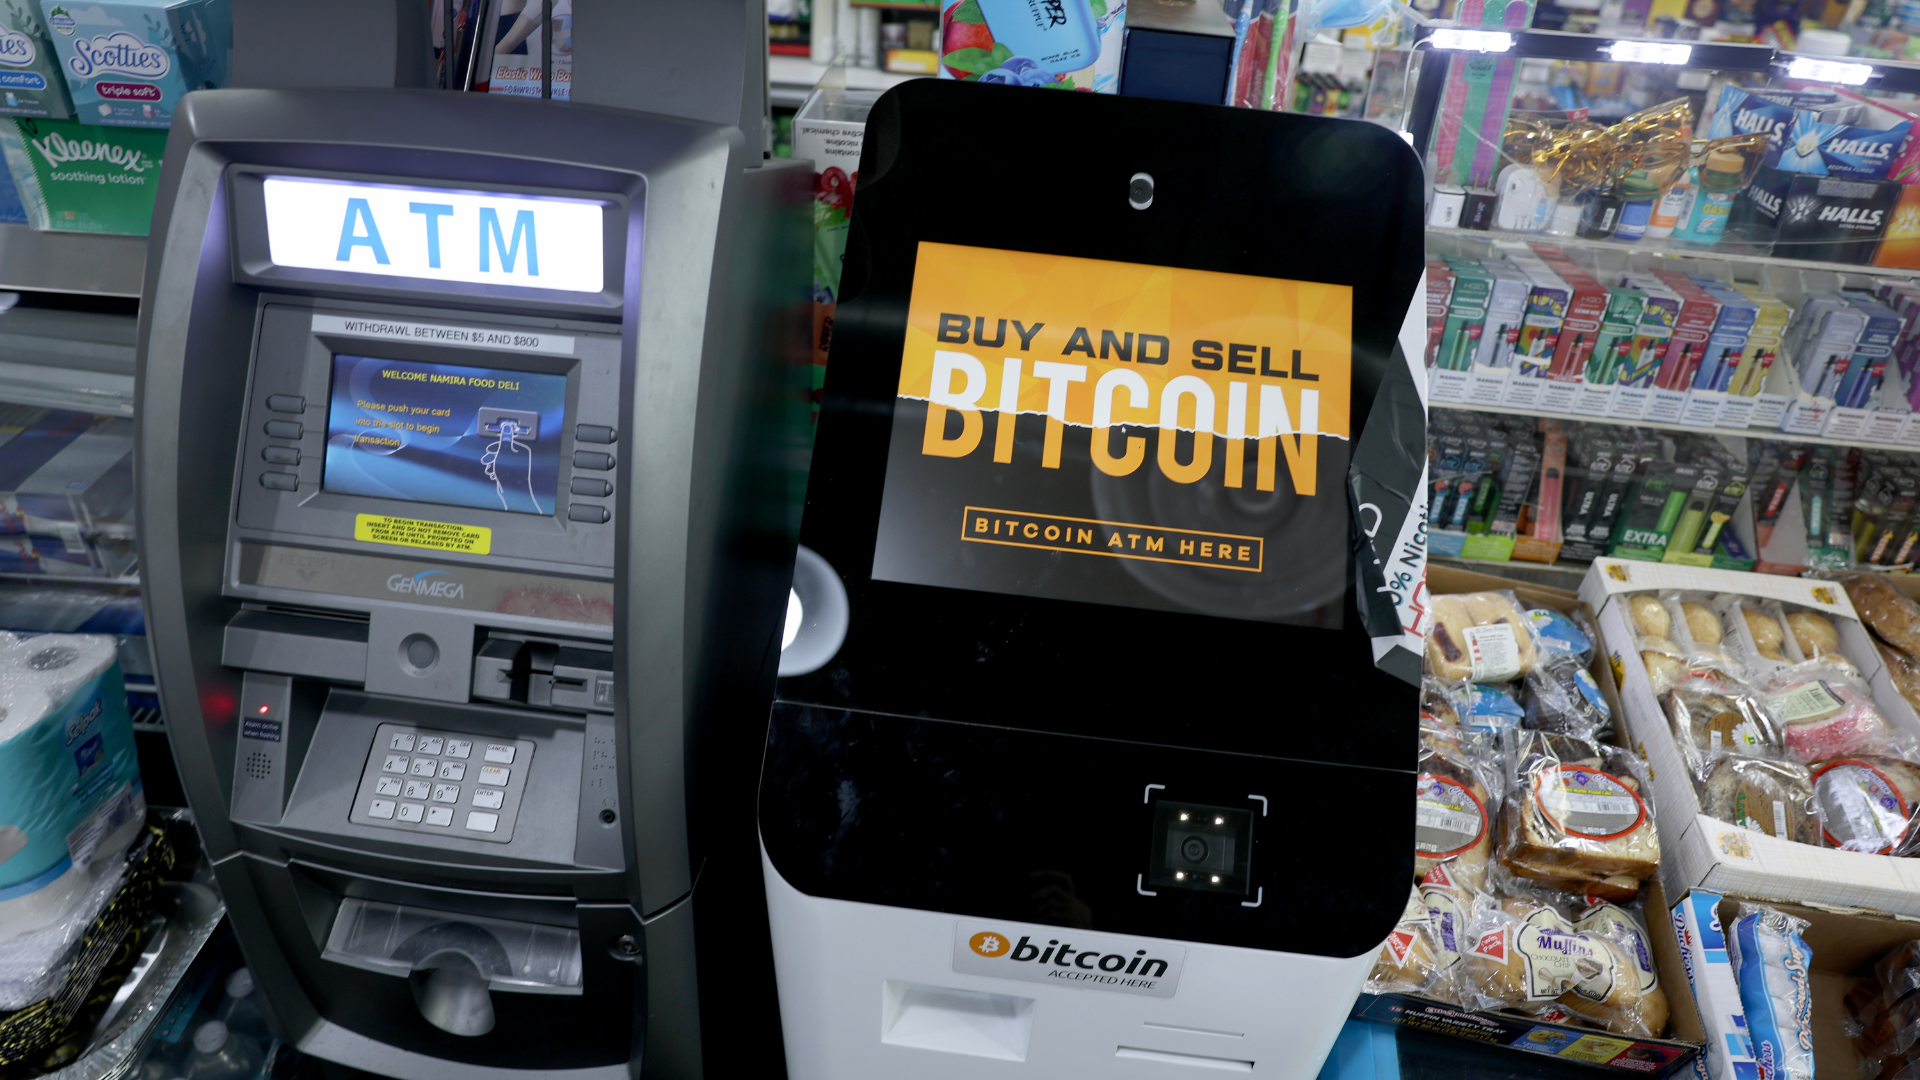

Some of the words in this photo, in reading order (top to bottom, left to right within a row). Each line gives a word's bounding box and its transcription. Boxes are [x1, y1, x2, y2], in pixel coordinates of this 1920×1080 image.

[69, 38, 162, 77] Scotties
[496, 66, 528, 81] Elastic
[101, 85, 132, 98] triple
[1735, 108, 1787, 147] HALLS
[32, 132, 144, 172] Kleenex
[1826, 137, 1894, 161] HALLS
[51, 170, 106, 185] soothing
[108, 172, 145, 185] lotion
[1748, 184, 1782, 215] HALLS
[1818, 205, 1884, 226] HALLS
[335, 197, 540, 277] ATM
[344, 321, 411, 337] WITHDRAWL
[414, 326, 469, 343] BETWEEN
[471, 331, 485, 344] $5
[487, 333, 511, 346] AND
[513, 335, 539, 349] $800
[937, 312, 1046, 352] BUY
[1061, 326, 1171, 366] AND
[1191, 339, 1320, 382] SELL
[382, 369, 428, 383] WELCOME
[430, 373, 466, 386] NAMIRA
[468, 377, 495, 389] FOOD
[497, 380, 520, 391] DELI
[357, 399, 386, 412] Please
[387, 403, 409, 416] push
[410, 406, 430, 417] your
[431, 406, 451, 418] card
[355, 416, 371, 427] into
[372, 417, 387, 429] the
[388, 418, 404, 430] slot
[405, 420, 415, 431] to
[416, 421, 441, 435] begin
[921, 349, 1320, 497] BITCOIN
[366, 521, 391, 530] INSERT
[433, 529, 461, 537] REMOVE
[393, 518, 415, 526] BEGIN
[372, 534, 399, 543] SCREEN
[410, 538, 445, 547] RELEASED
[406, 532, 426, 540] UNTIL
[427, 534, 463, 544] PROMPTED
[974, 516, 1094, 546] BITCOIN
[1107, 530, 1164, 553] ATM
[1179, 539, 1252, 562] HERE
[1623, 529, 1667, 547] EXTRA
[279, 554, 338, 570] RECEIPT
[386, 573, 465, 600] GENMEGA
[67, 698, 102, 747] Selpak
[245, 720, 261, 729] Alarm
[262, 723, 279, 731] active
[394, 739, 399, 749] 1
[419, 742, 428, 751] 2
[449, 744, 456, 755] 3
[487, 743, 508, 752] CANCEL
[385, 761, 393, 770] 4
[413, 763, 421, 773] 5
[442, 767, 449, 777] 6
[380, 783, 387, 791] 7
[407, 786, 414, 796] 8
[436, 789, 444, 799] 9
[401, 807, 409, 817] 0
[1483, 939, 1502, 954] Pack
[1537, 936, 1594, 958] Muffins
[1673, 912, 1695, 986] Duchess
[1009, 936, 1169, 979] bitcoin
[1530, 953, 1570, 962] CHOCOLATE
[1553, 960, 1571, 969] CHIP
[1048, 969, 1118, 986] ACCEPTED
[1119, 978, 1158, 990] HERE
[1404, 1009, 1441, 1021] MUFFIN
[1441, 1017, 1481, 1030] VARIETY
[1481, 1025, 1507, 1034] TRAY
[1758, 1040, 1774, 1080] uchess
